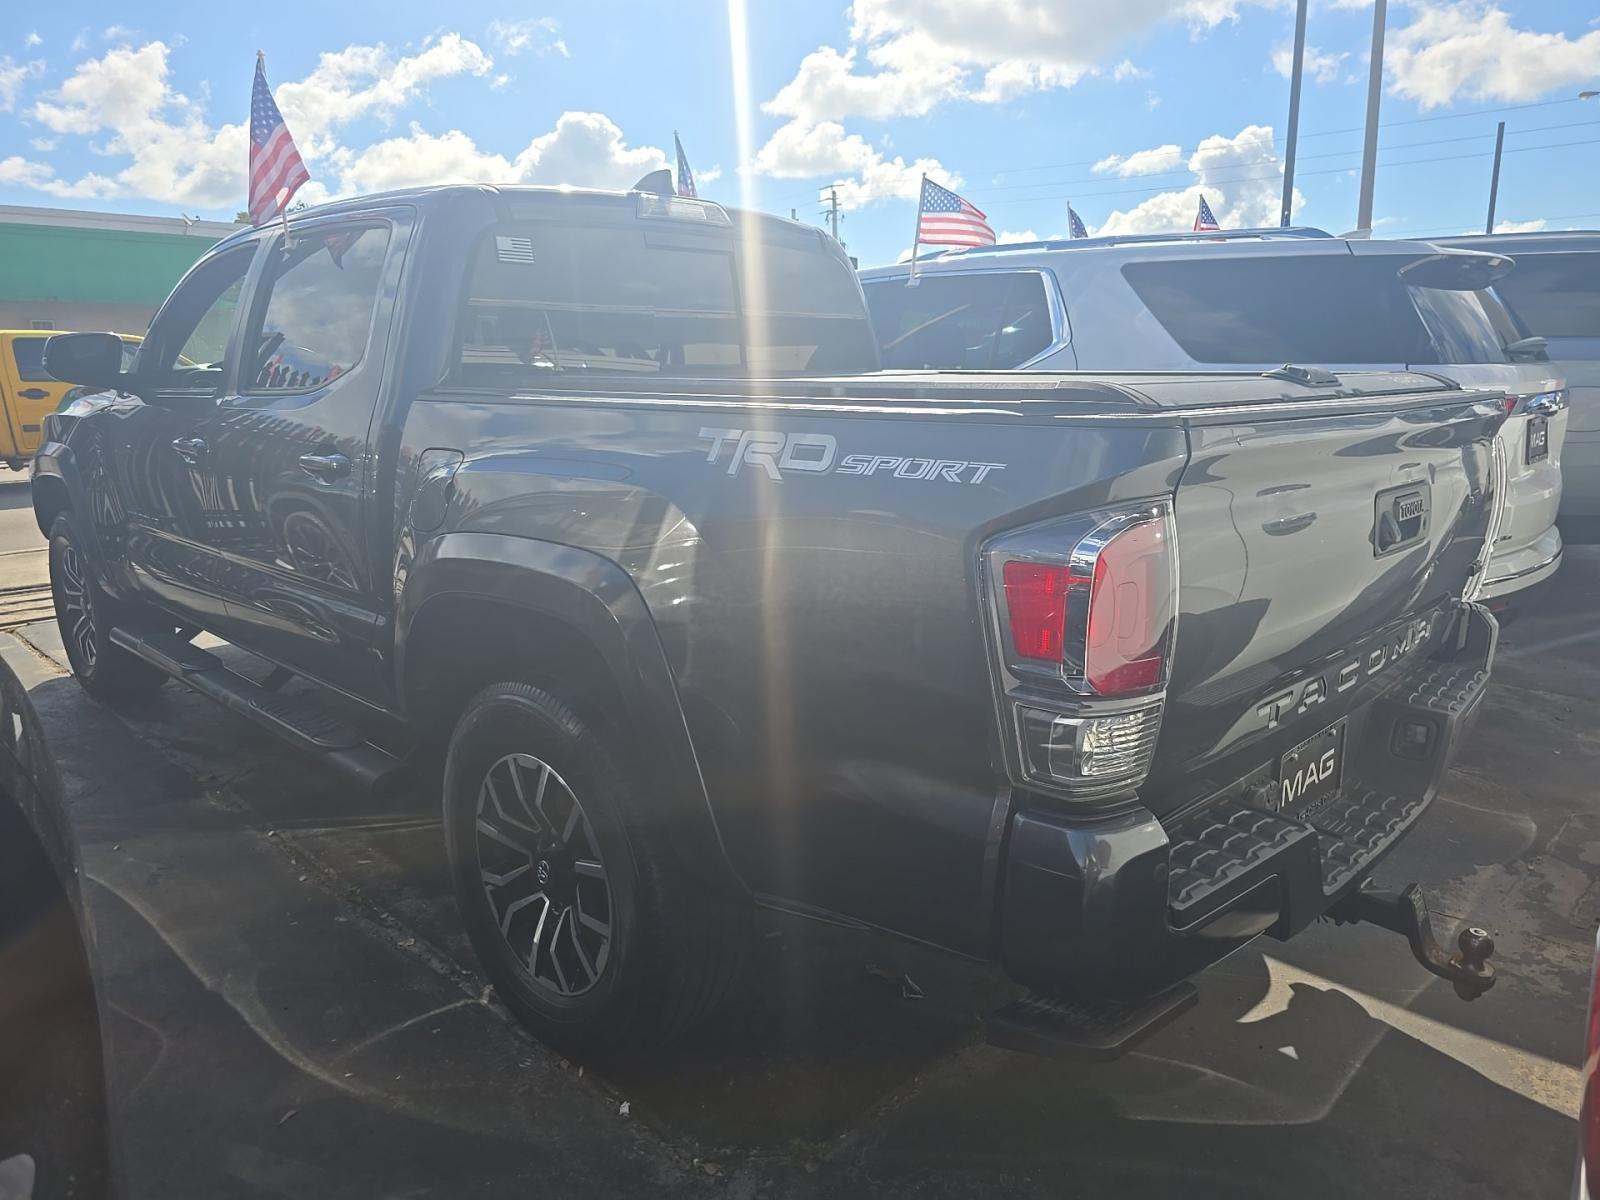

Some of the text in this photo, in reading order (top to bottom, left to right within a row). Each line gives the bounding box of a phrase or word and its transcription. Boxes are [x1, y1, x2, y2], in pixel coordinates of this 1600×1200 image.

[698, 426, 1008, 484] TRD SPORT
[1530, 431, 1545, 446] MAG
[1256, 618, 1431, 729] TACOMA
[1281, 748, 1335, 808] MAG
